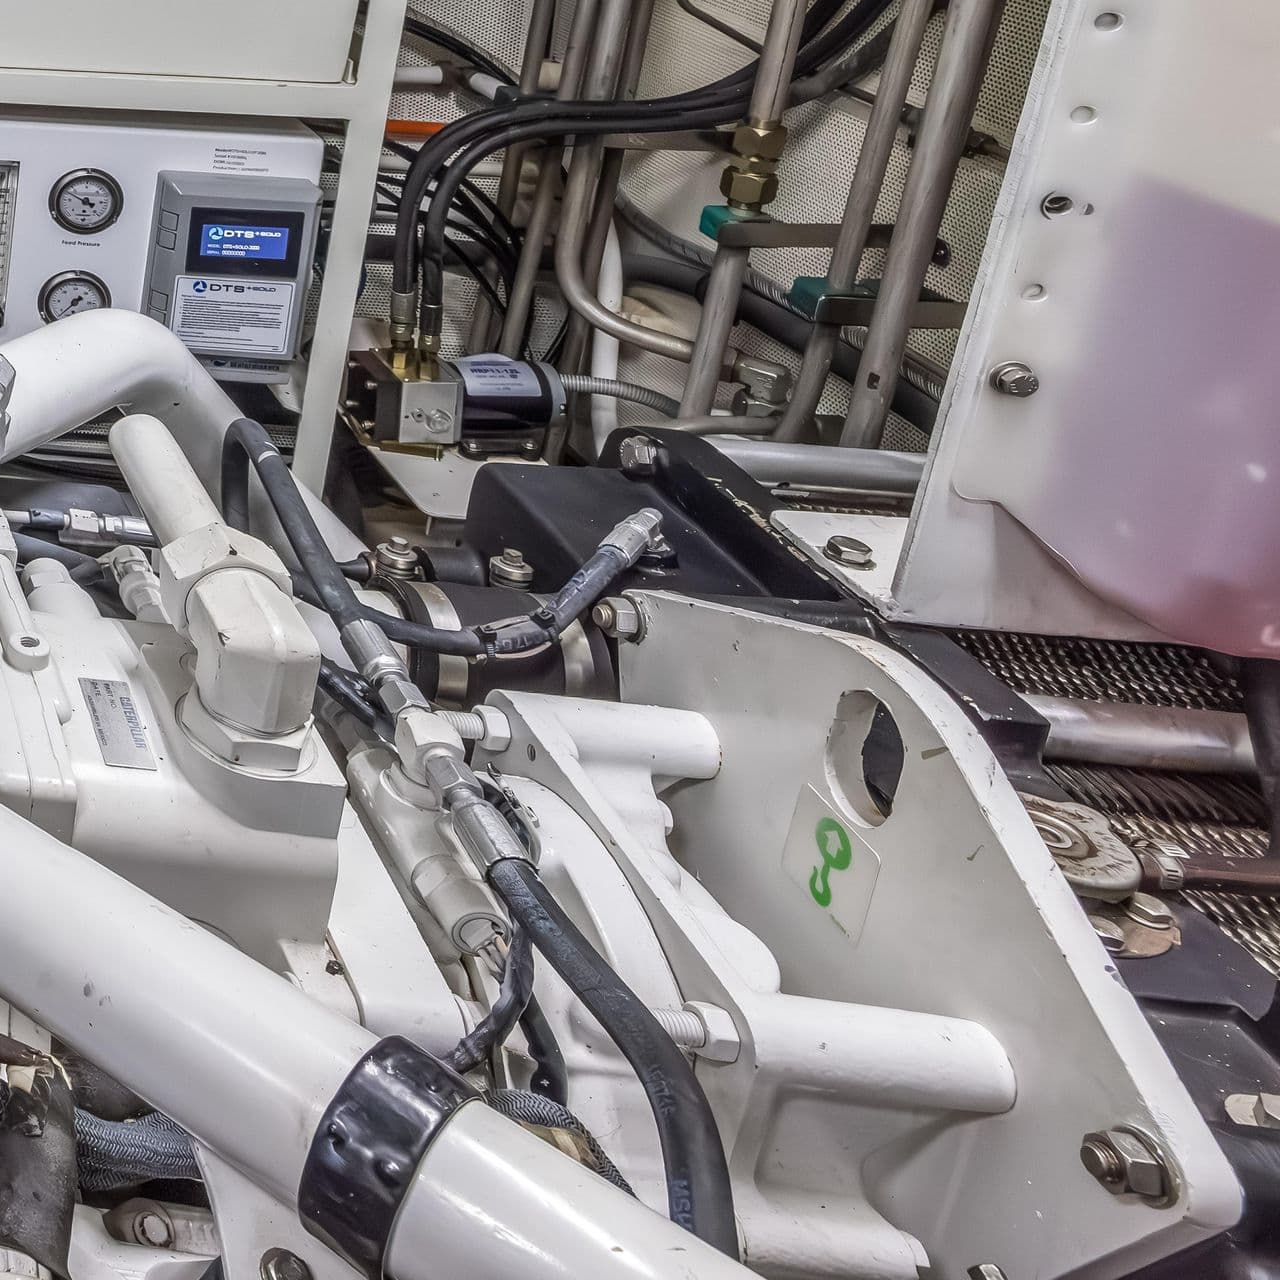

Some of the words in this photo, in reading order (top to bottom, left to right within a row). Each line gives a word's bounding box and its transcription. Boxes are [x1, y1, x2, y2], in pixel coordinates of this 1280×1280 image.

[223, 229, 254, 238] DTS
[209, 283, 245, 293] DTS
[119, 696, 147, 749] CATERPILLAR
